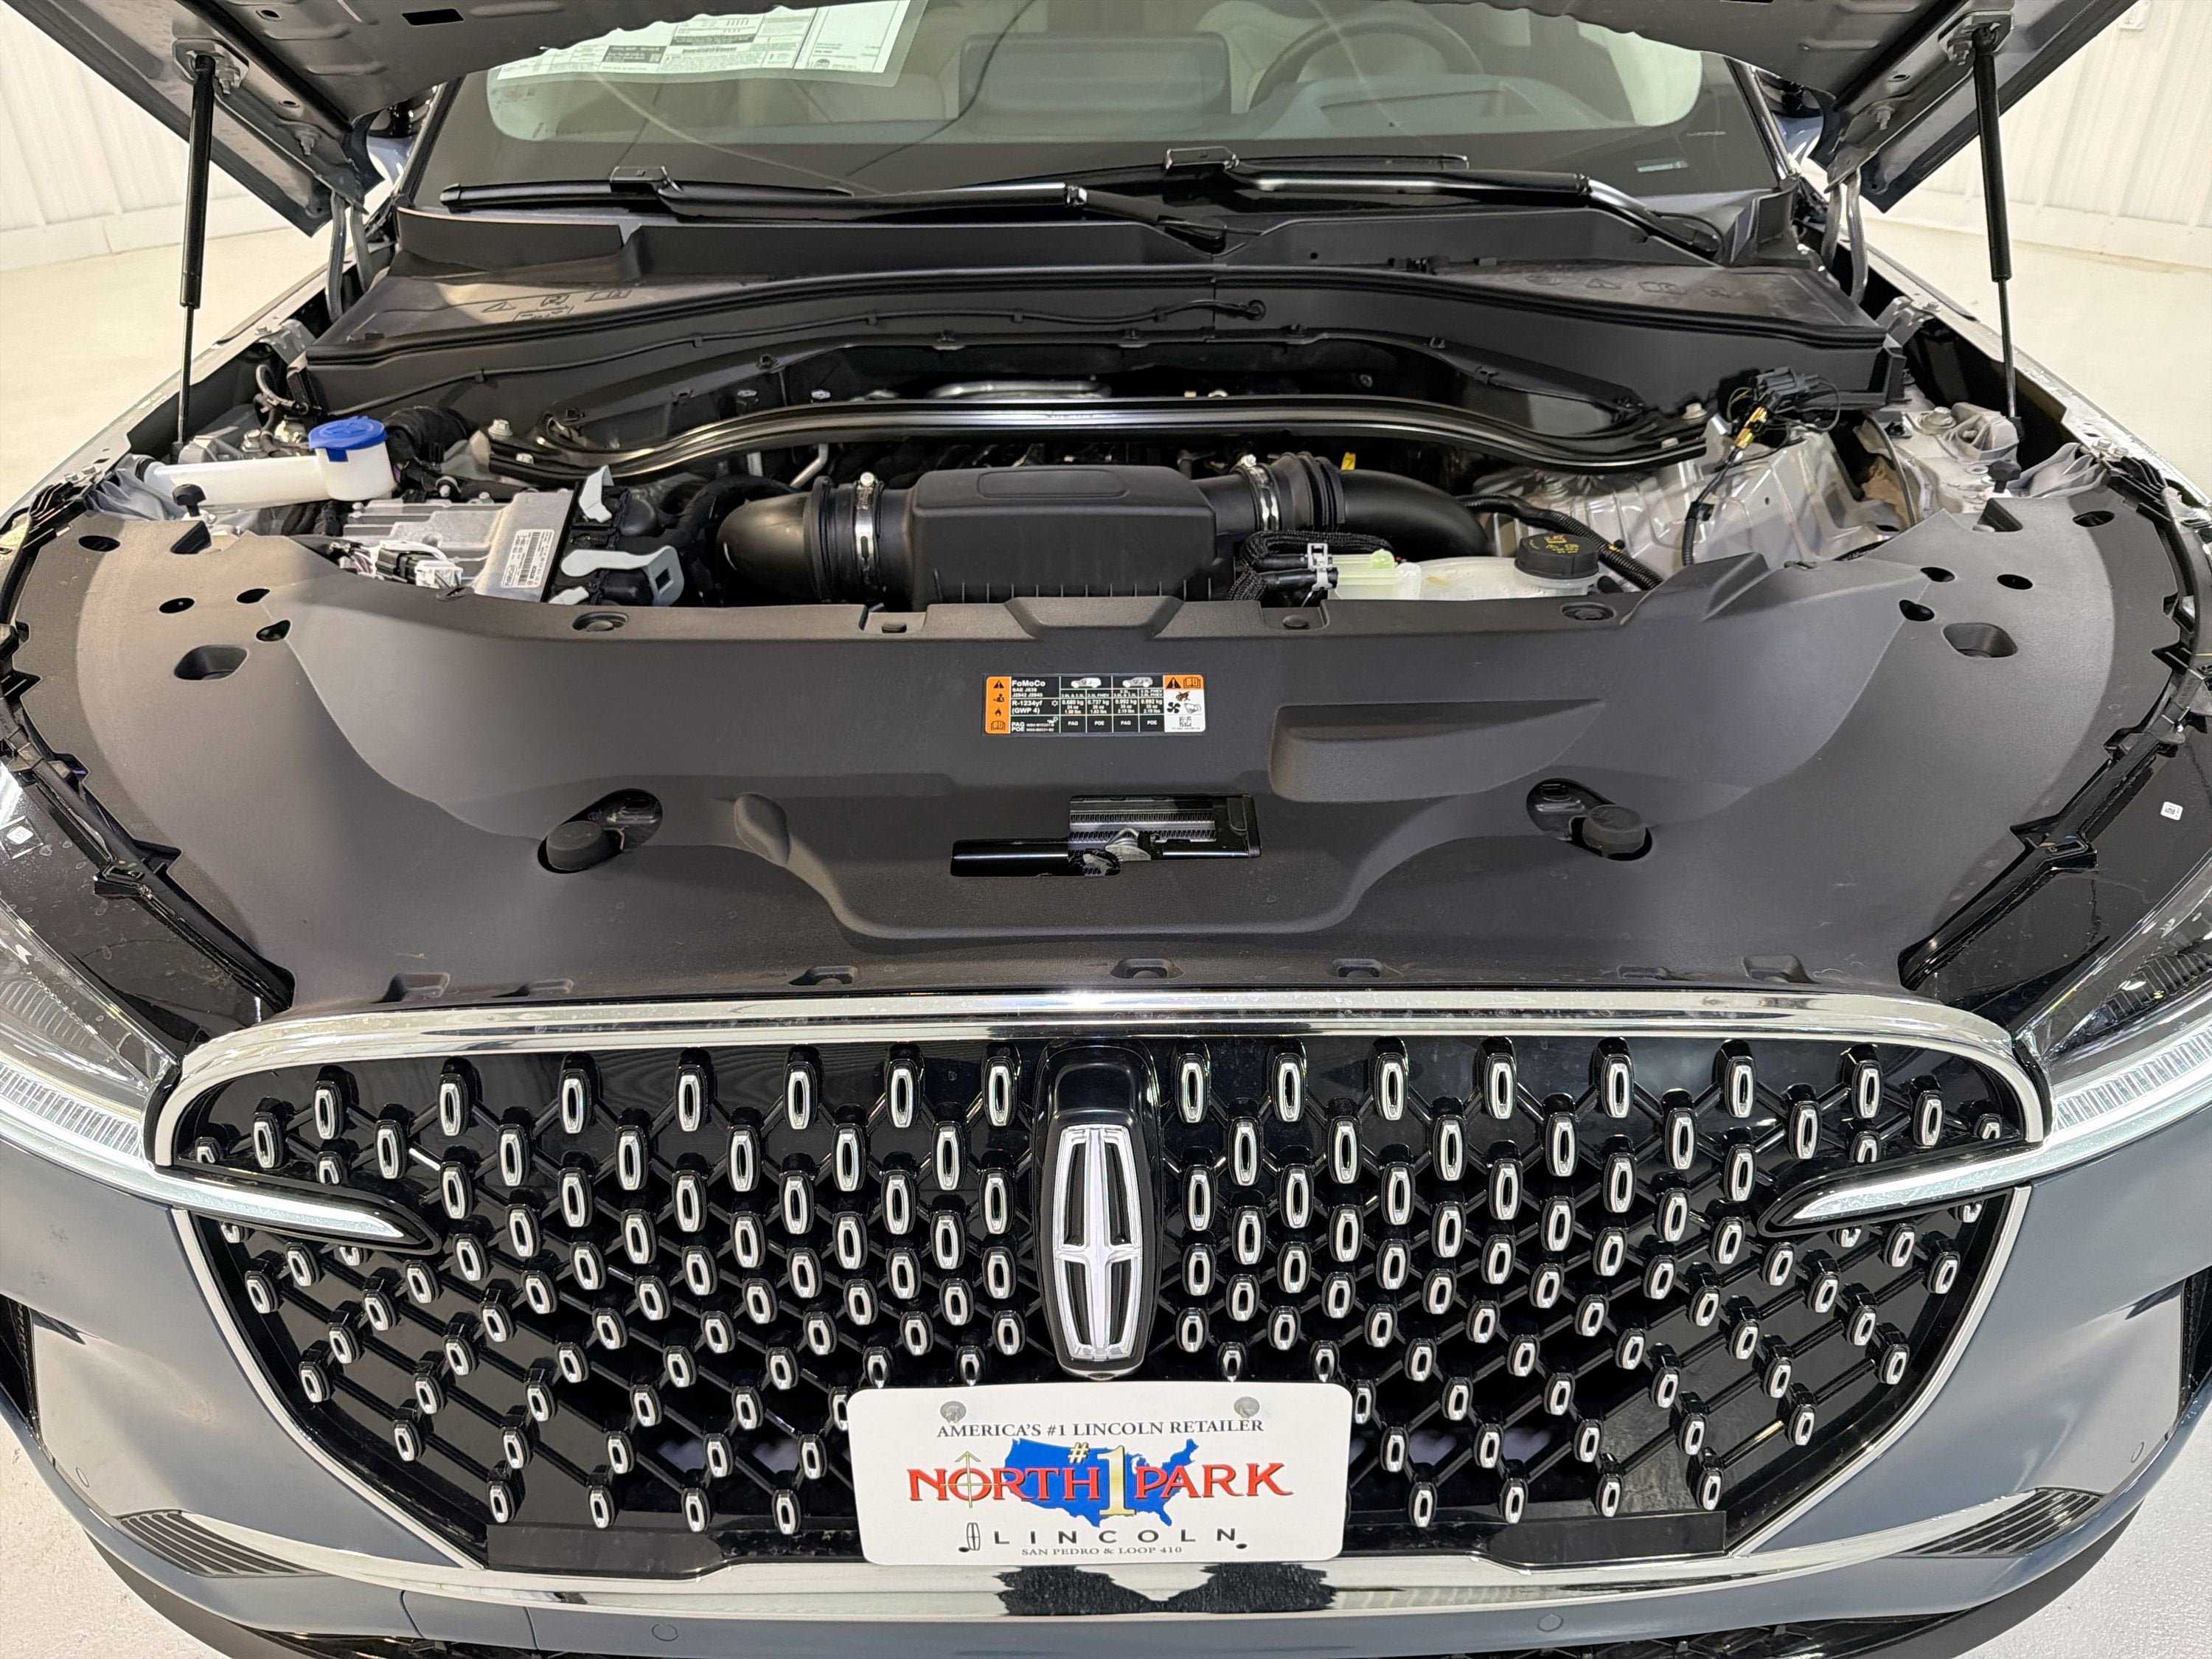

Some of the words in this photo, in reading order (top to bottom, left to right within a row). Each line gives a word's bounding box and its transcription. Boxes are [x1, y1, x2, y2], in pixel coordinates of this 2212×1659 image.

[937, 1423, 1041, 1438] AMERICA'S
[1047, 1424, 1066, 1436] #1
[1074, 1422, 1164, 1436] LINCOLN
[1169, 1419, 1264, 1433] RETAILER
[907, 1466, 1100, 1502] NORTH
[1135, 1462, 1294, 1499] PARK
[994, 1528, 1236, 1545] LINCOLN
[1021, 1548, 1048, 1556] SAN
[1053, 1547, 1099, 1555] PEDRO
[1119, 1546, 1156, 1554] LOOP
